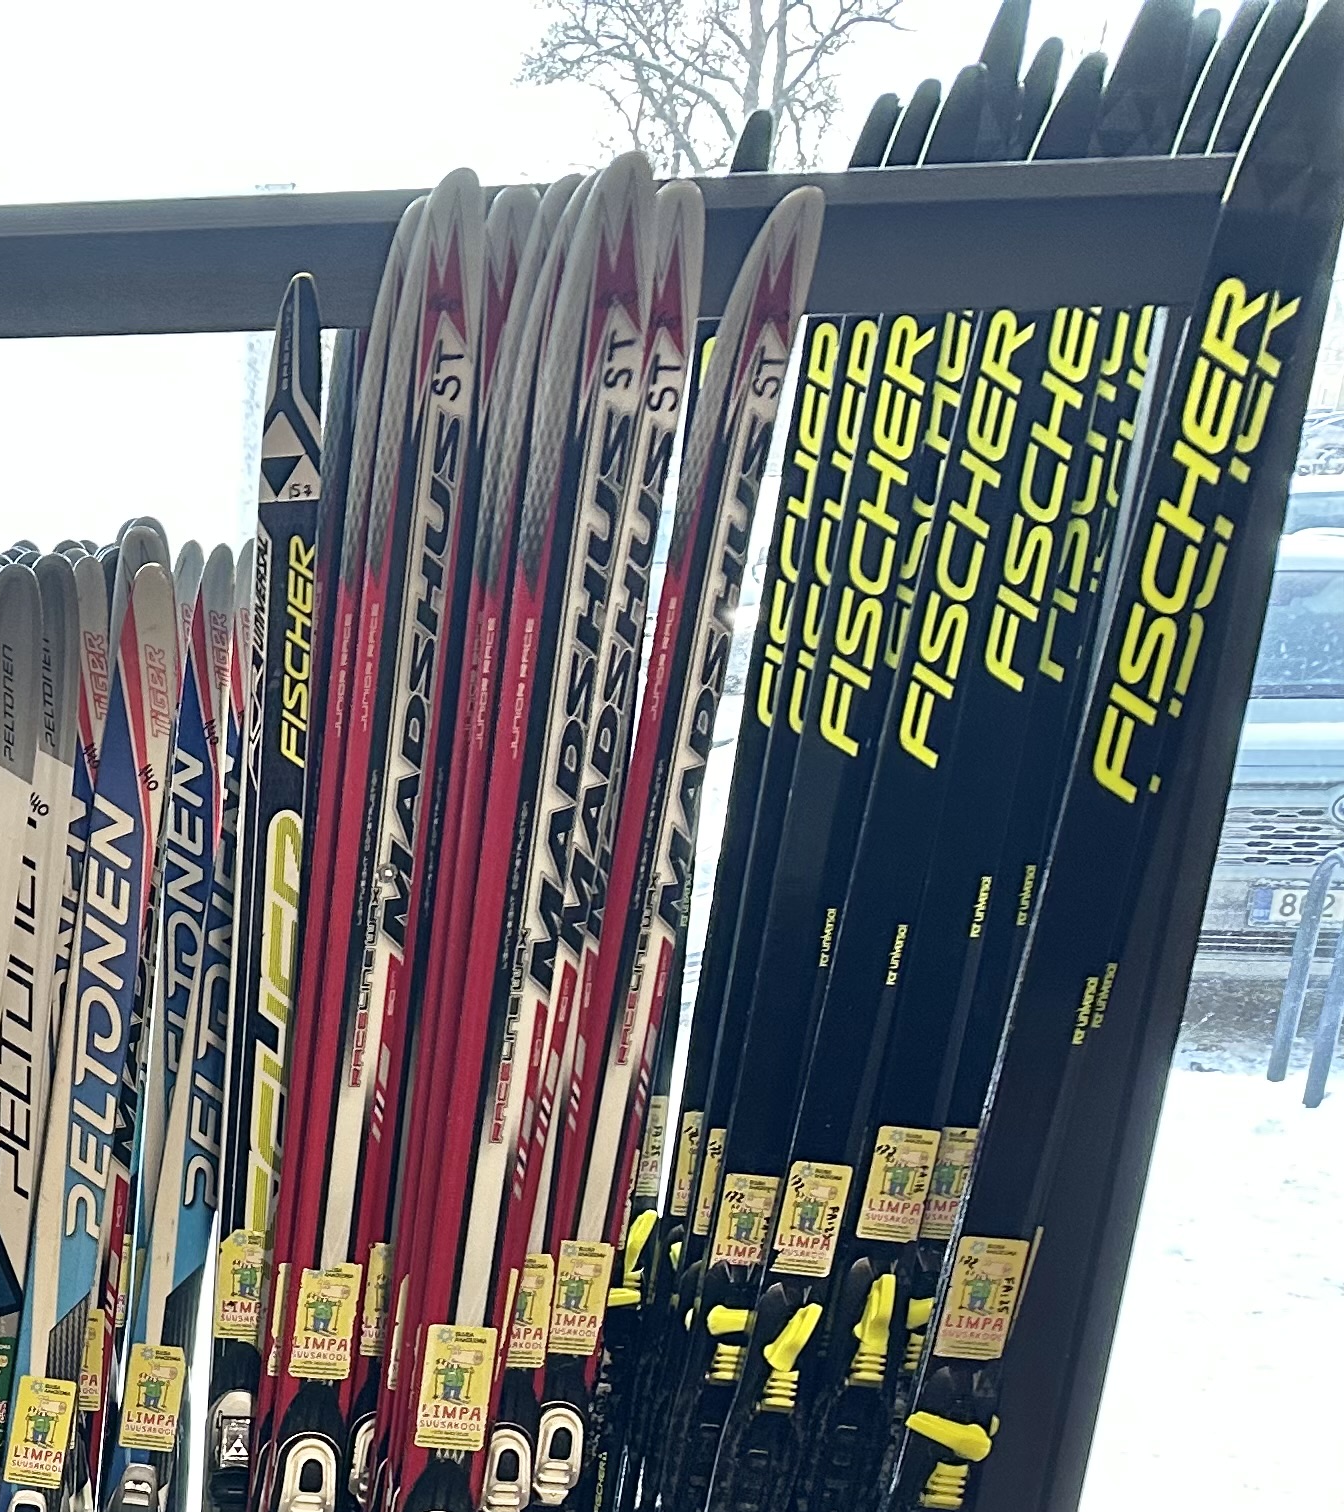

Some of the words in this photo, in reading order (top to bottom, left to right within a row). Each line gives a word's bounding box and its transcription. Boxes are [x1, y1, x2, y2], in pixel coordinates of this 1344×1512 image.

[432, 338, 467, 401] ST
[603, 332, 639, 392] ST
[647, 354, 685, 413] ST
[752, 346, 787, 398] ST
[251, 536, 272, 652] UNIVERSAL
[819, 313, 936, 759] FISCHER
[900, 308, 1037, 770] FISCHER
[1091, 277, 1269, 804] FISCHER
[0, 643, 14, 763] PELTONEN
[278, 533, 316, 769] FISCHER
[379, 408, 466, 949] MADSHUS
[526, 408, 633, 999] MADSHUS
[655, 411, 774, 936] MADSHUS
[64, 793, 137, 1241] PELTONEN
[13, 1445, 63, 1464] LIMPA
[126, 1411, 176, 1430] LIMPA
